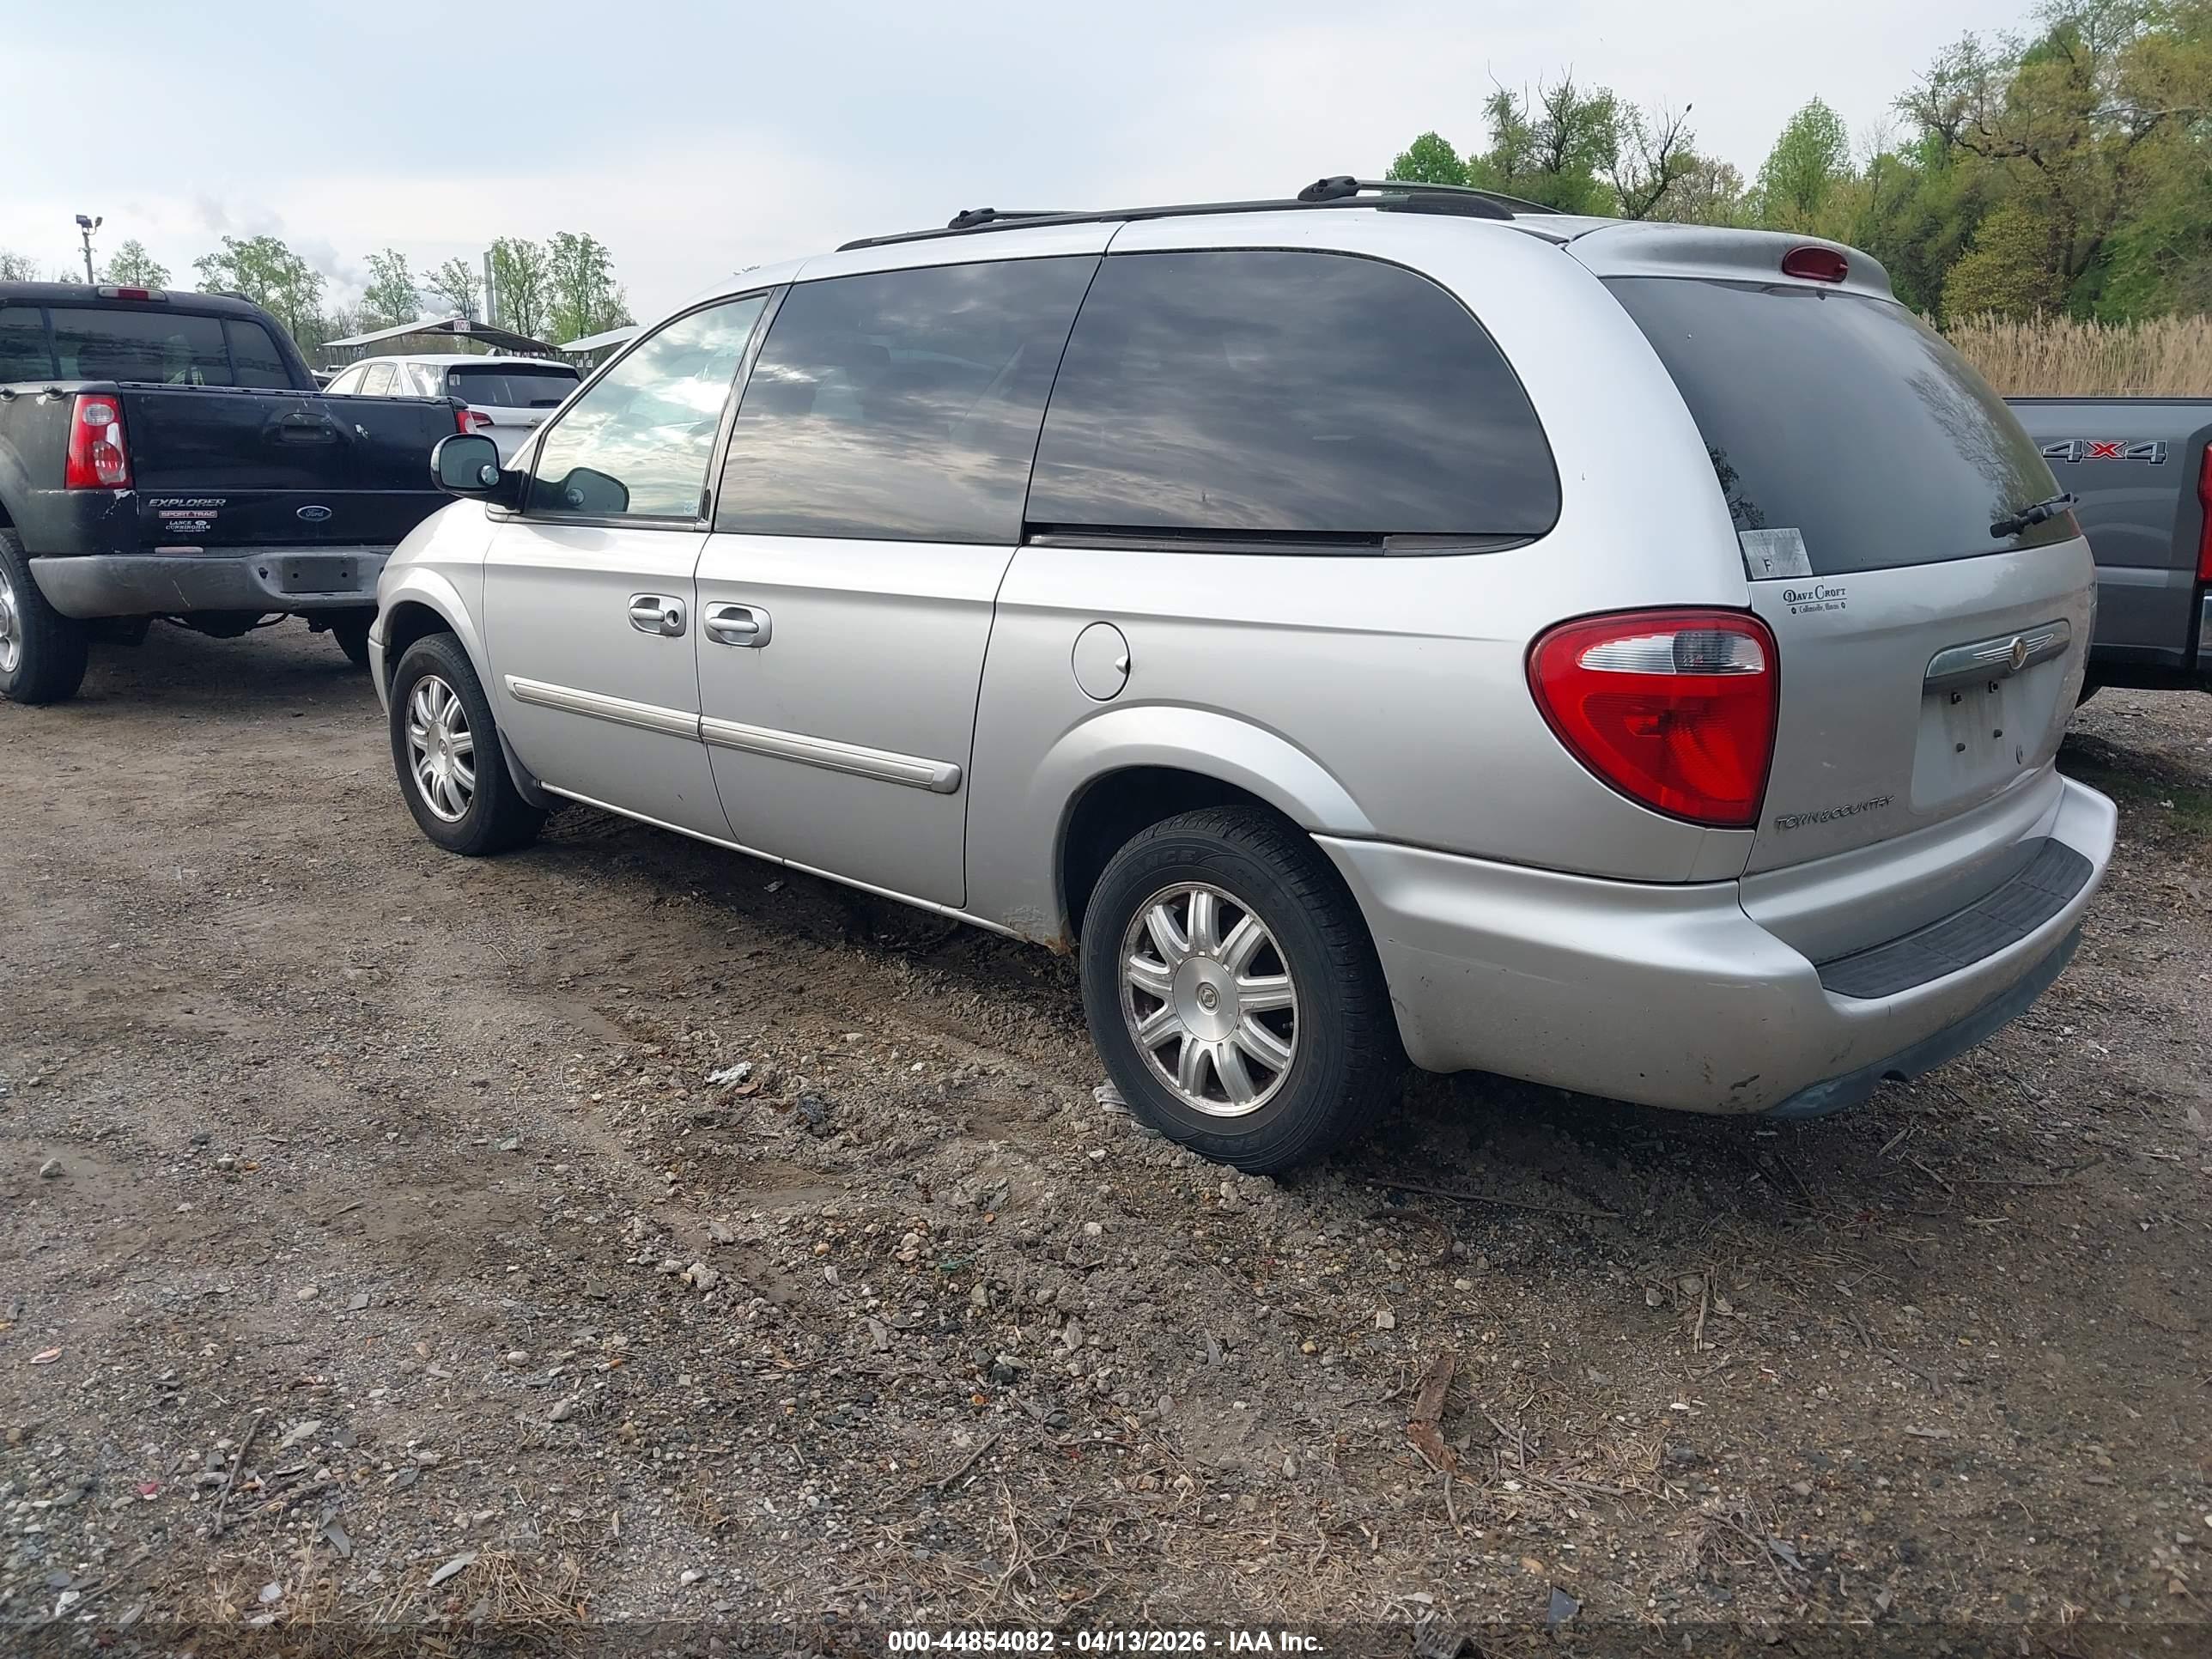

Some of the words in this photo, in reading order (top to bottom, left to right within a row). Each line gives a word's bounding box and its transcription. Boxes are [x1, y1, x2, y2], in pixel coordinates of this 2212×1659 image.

[148, 498, 227, 507] EXPLORER
[1783, 589, 1814, 603] DAVE
[1814, 585, 1846, 599] CROFT
